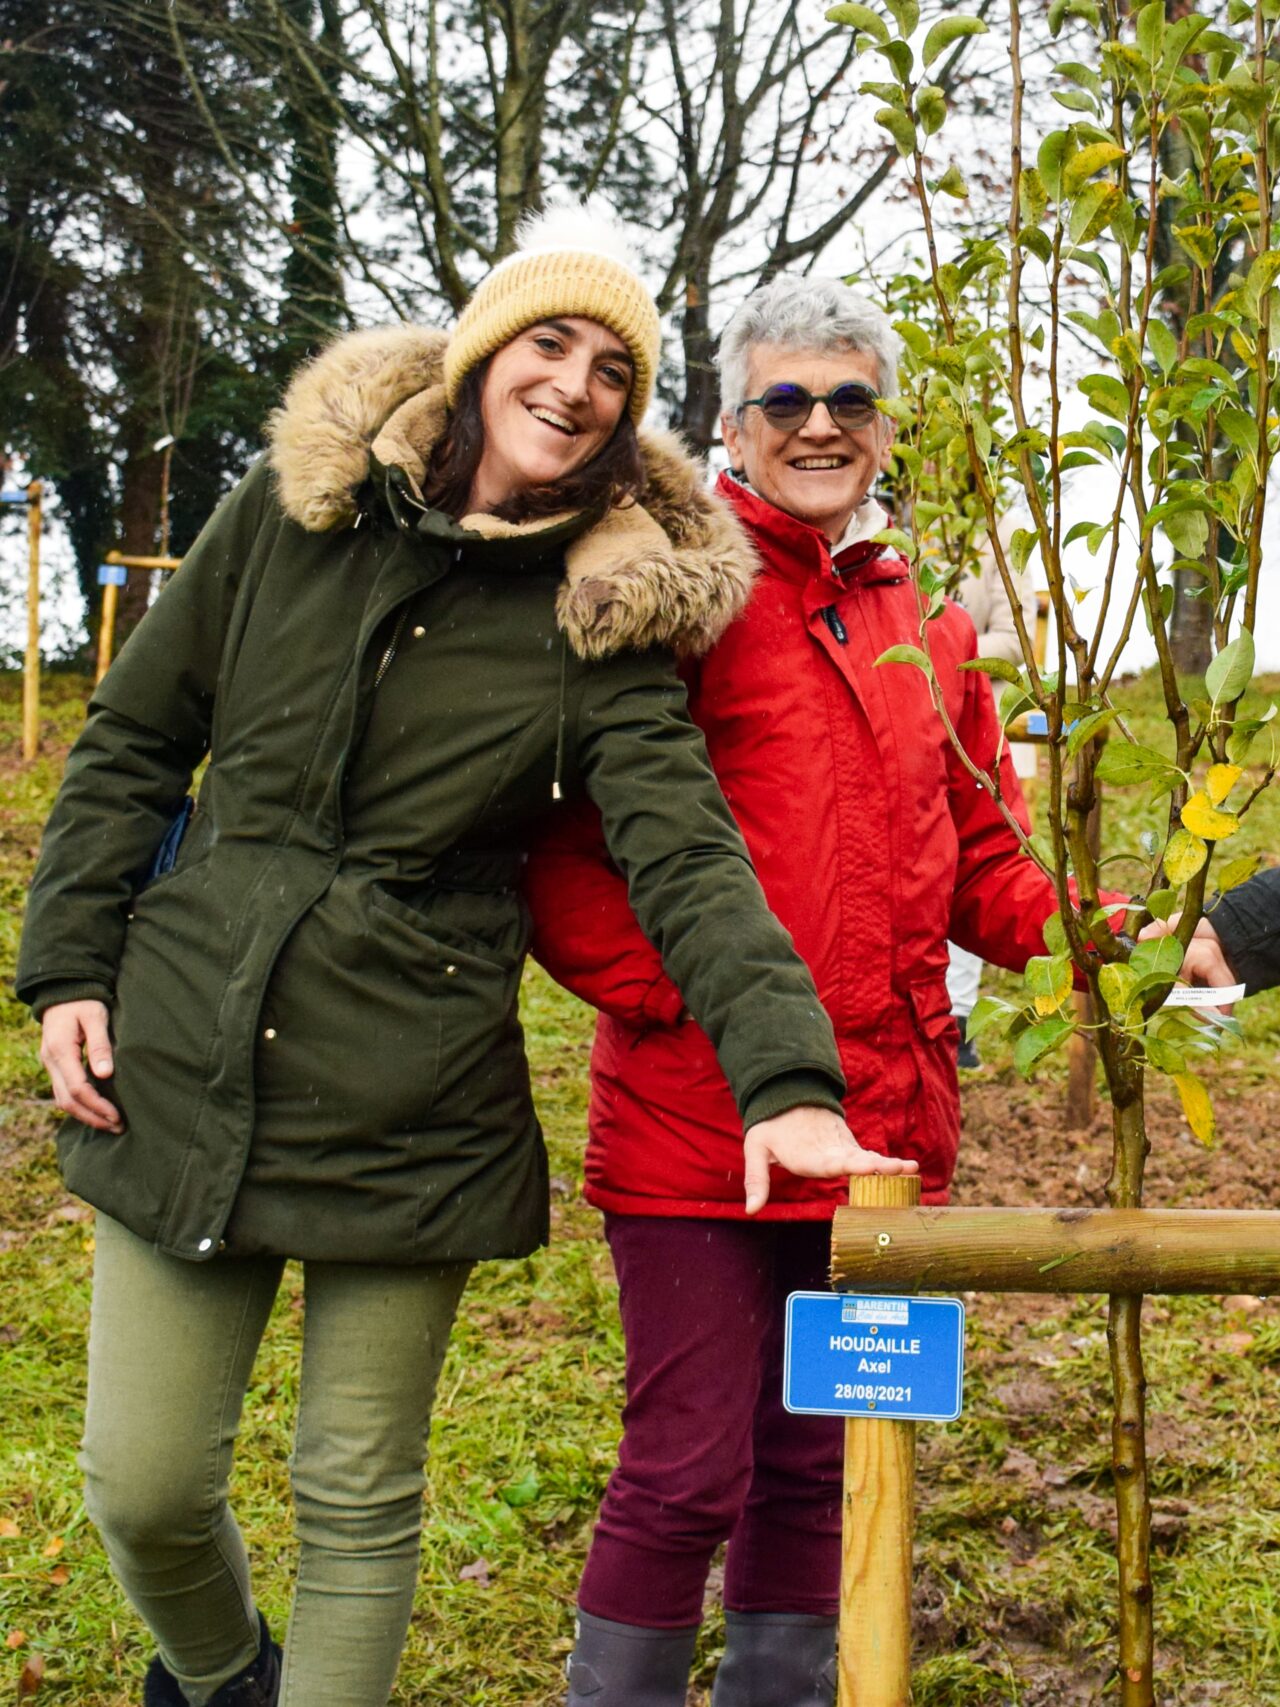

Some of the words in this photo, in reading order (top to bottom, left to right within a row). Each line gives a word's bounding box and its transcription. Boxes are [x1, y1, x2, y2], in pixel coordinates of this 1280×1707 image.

[856, 1300, 908, 1312] BARENTIN
[830, 1335, 920, 1354] HOUDAILLE
[858, 1358, 891, 1374] Axel
[834, 1384, 911, 1402] 28/08/2021
